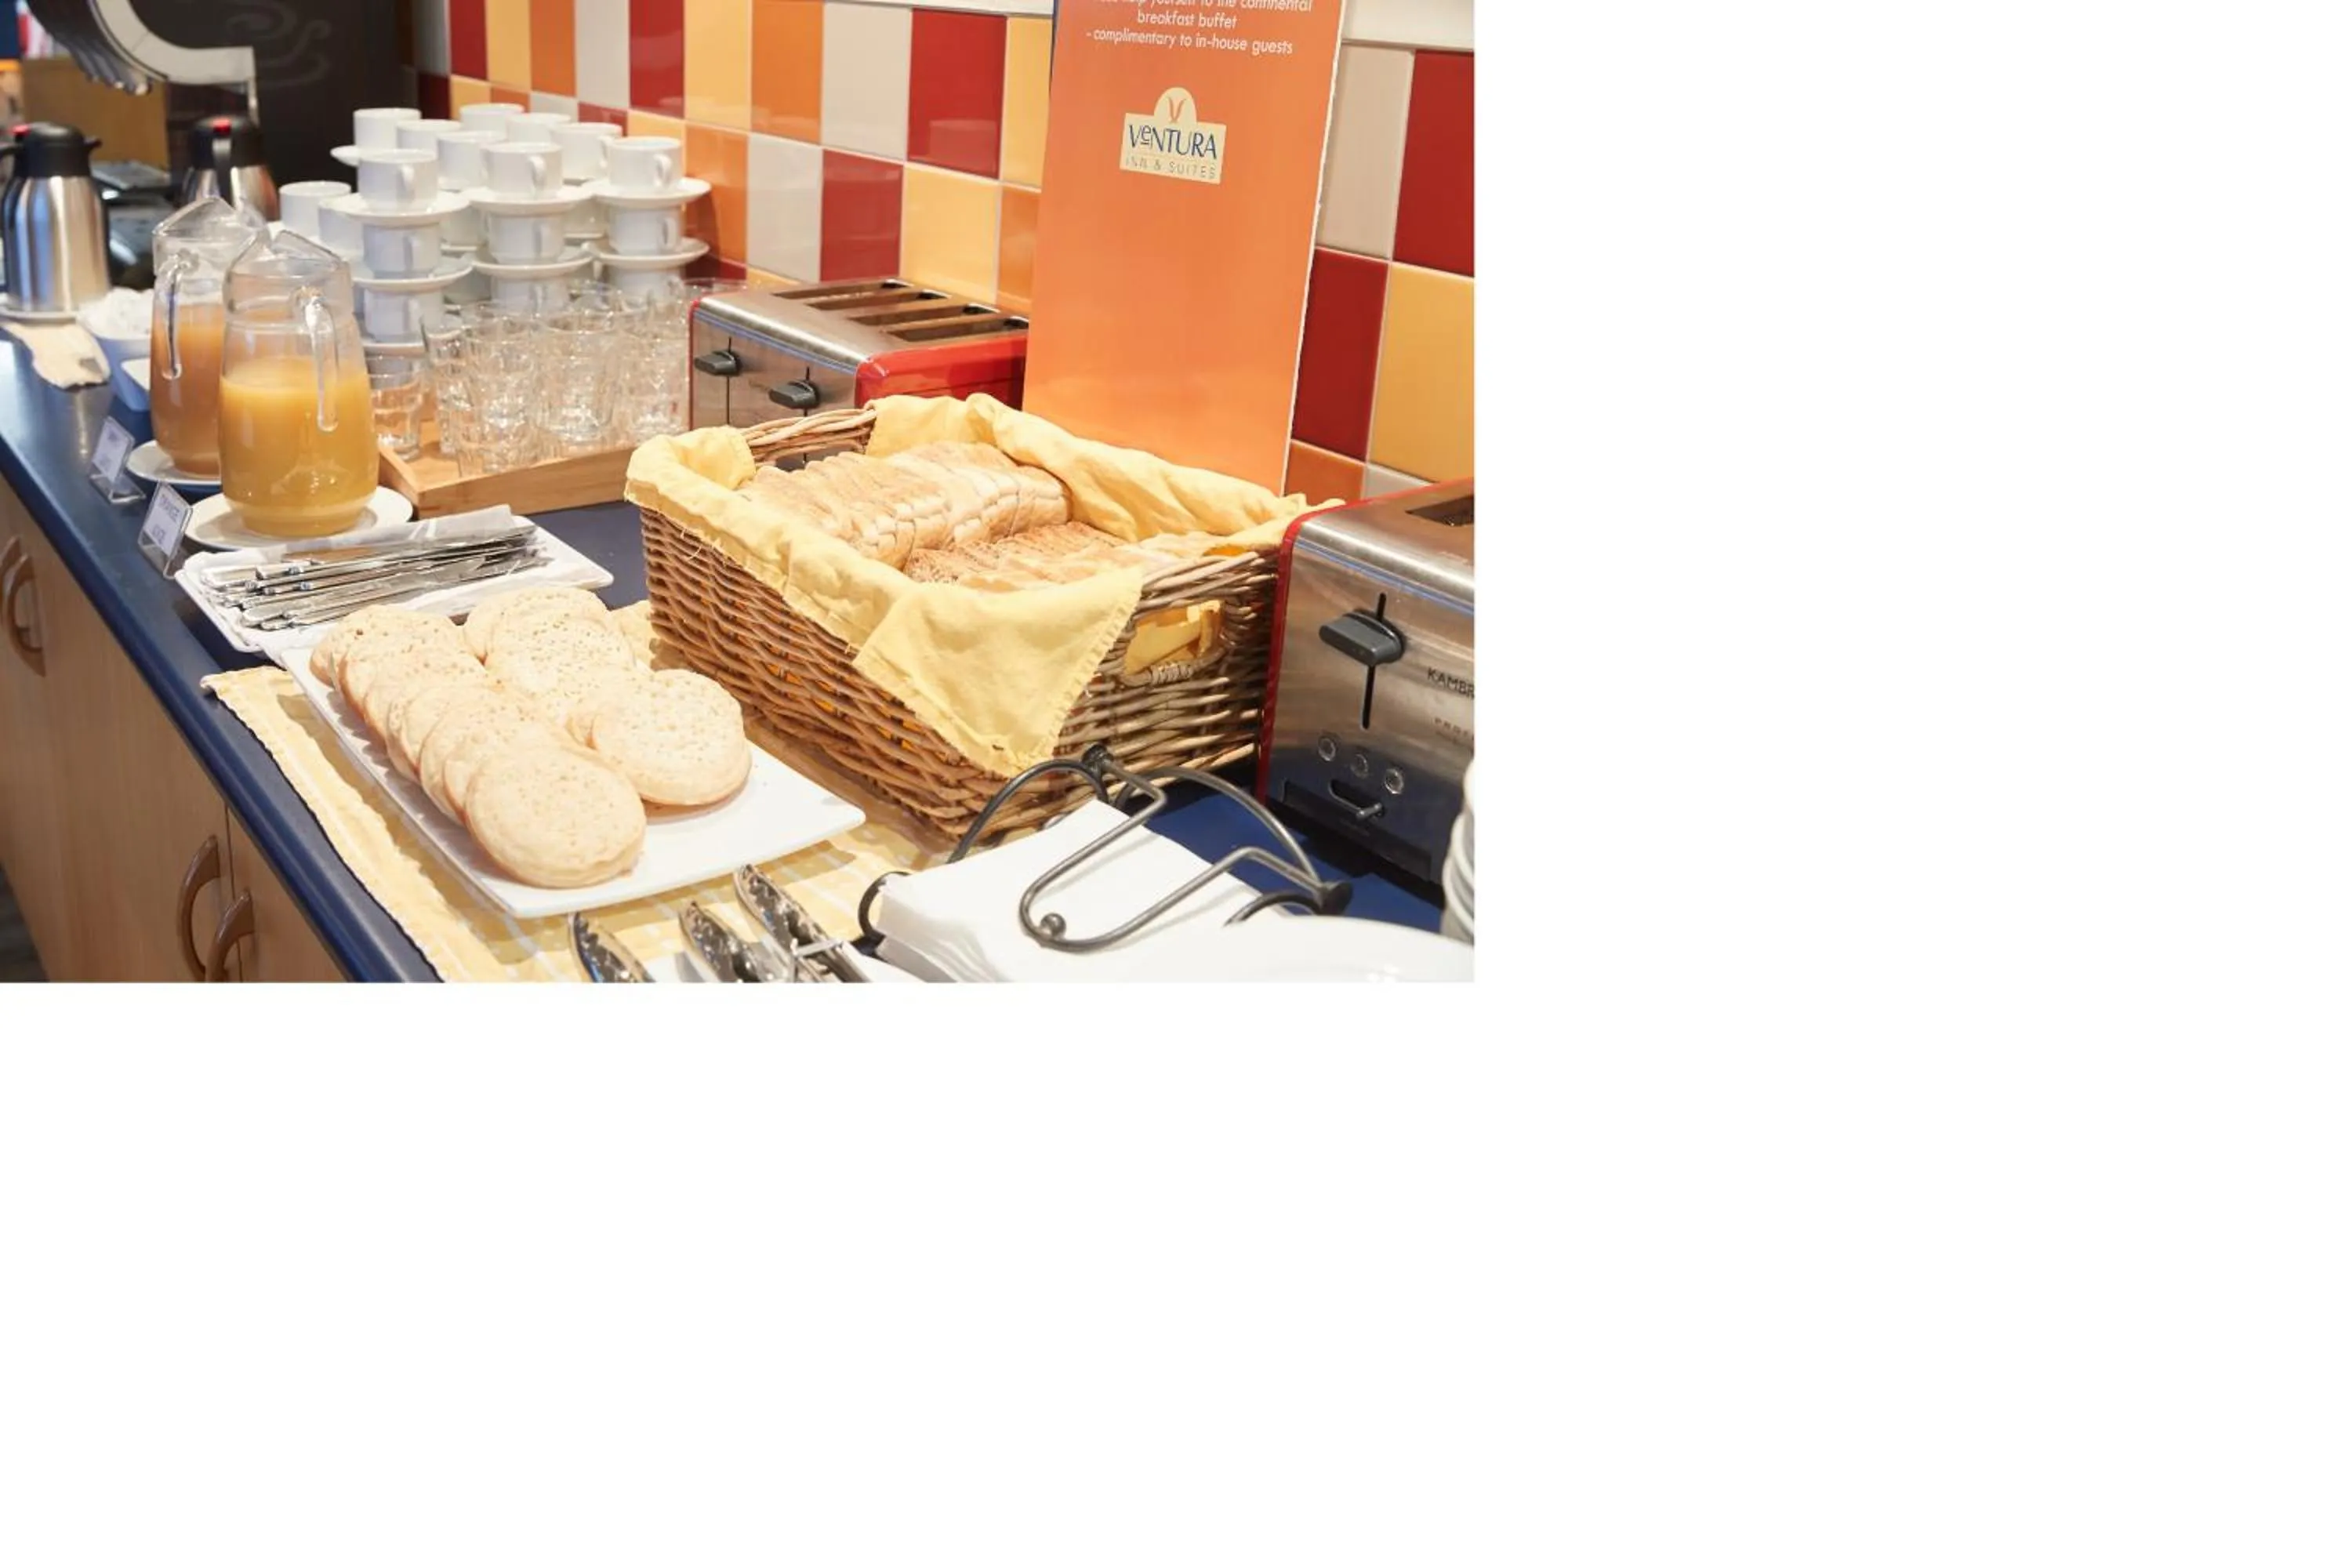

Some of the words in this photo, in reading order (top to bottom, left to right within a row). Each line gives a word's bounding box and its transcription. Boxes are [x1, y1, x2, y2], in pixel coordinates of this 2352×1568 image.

[1240, 0, 1313, 12] continental
[1137, 9, 1195, 26] breakfast
[1198, 13, 1237, 29] buffet
[1094, 27, 1177, 49] complimentary
[1180, 34, 1192, 47] to
[1196, 32, 1247, 51] in-house
[1252, 40, 1294, 56] guests
[1168, 161, 1217, 180] SUITES
